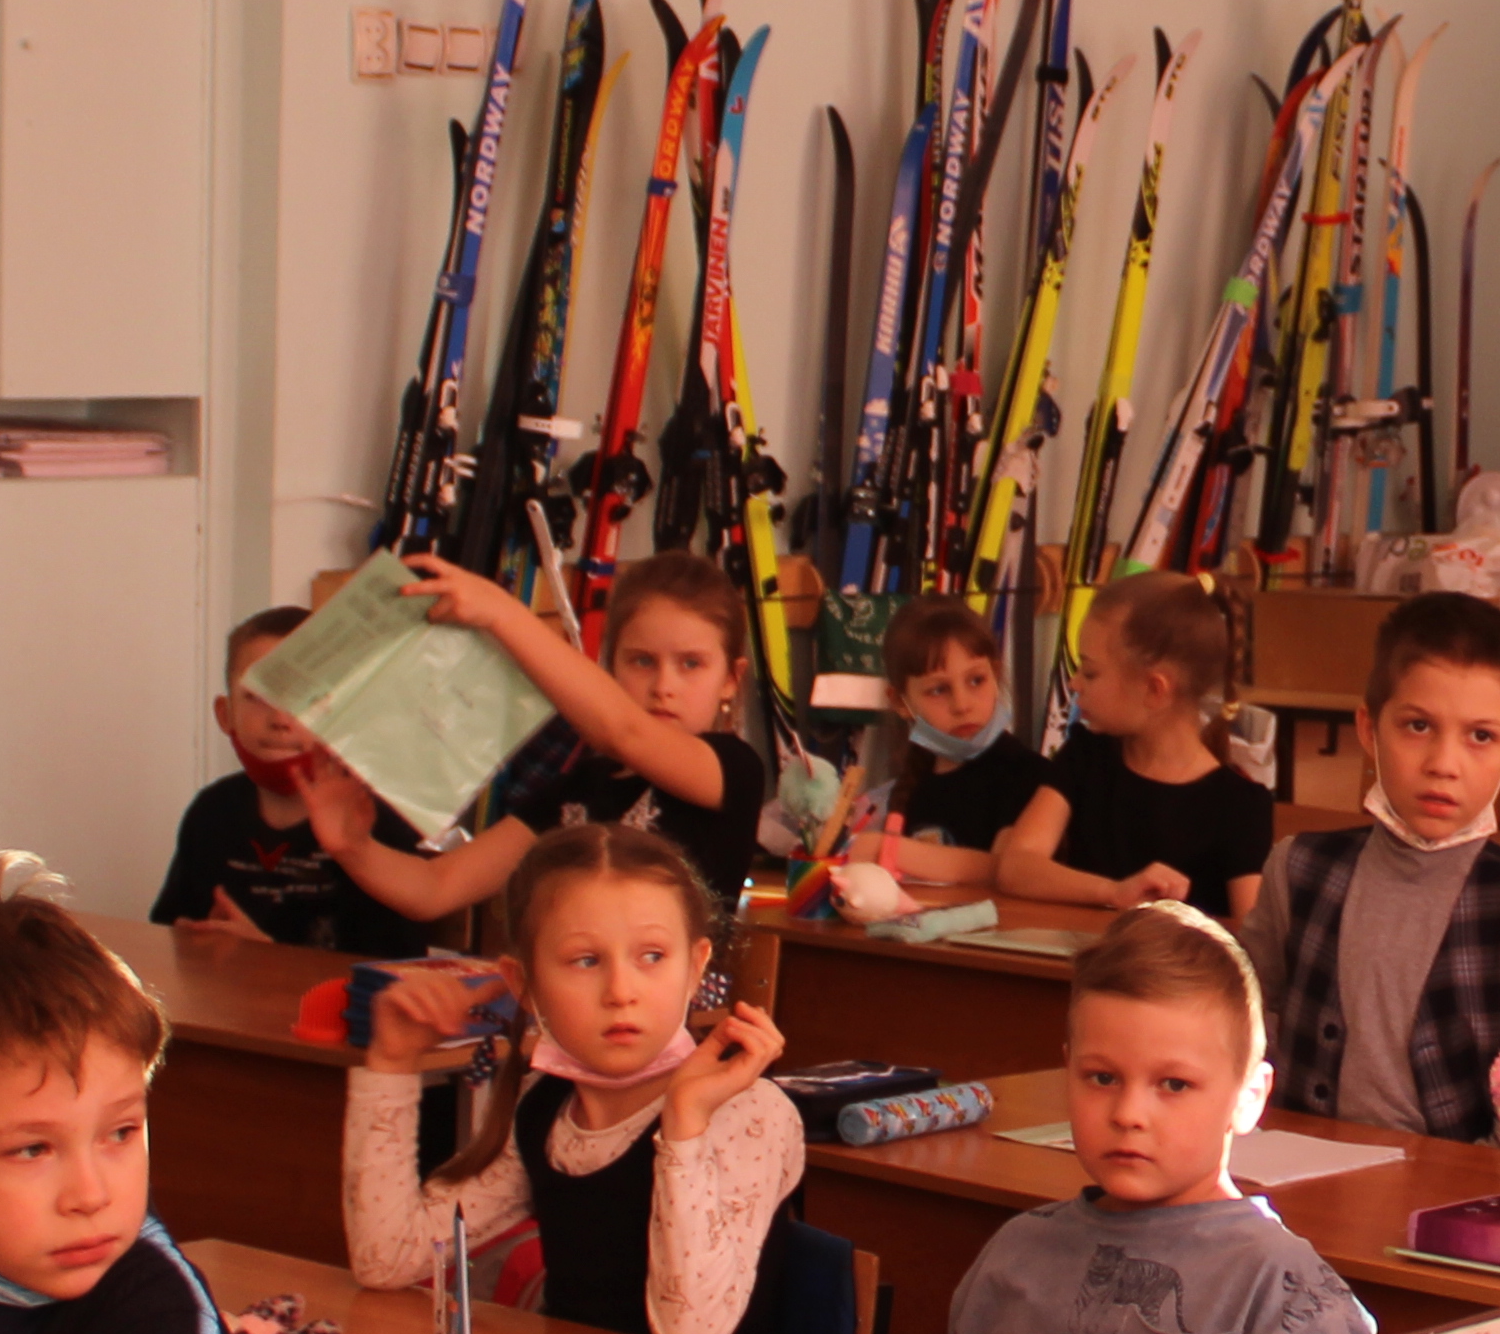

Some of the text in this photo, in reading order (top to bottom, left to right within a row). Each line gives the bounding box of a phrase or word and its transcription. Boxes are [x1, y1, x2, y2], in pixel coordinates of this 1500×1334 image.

[465, 61, 513, 236] NORDWAY
[658, 57, 697, 181] ORDWAY
[936, 88, 972, 246] NORDWAY
[1246, 178, 1293, 283] RDWAY
